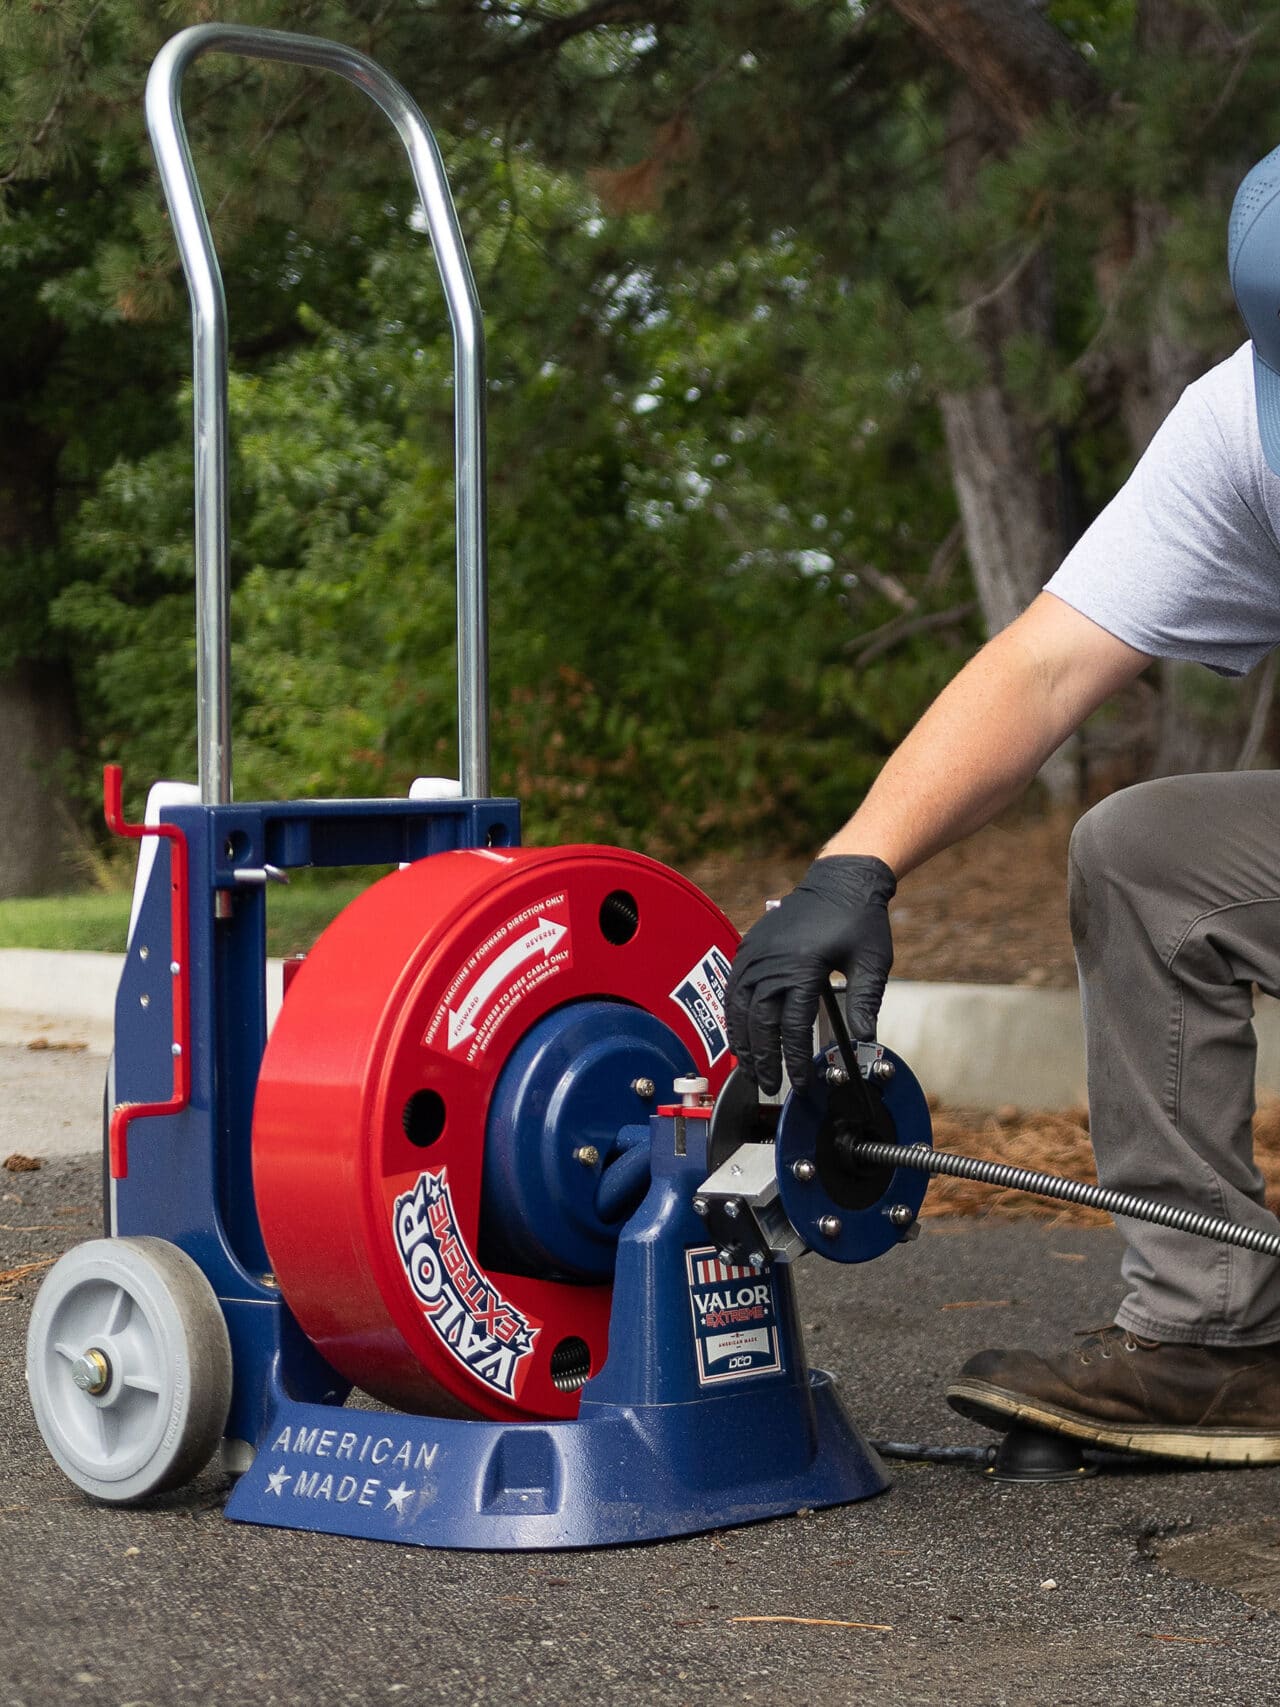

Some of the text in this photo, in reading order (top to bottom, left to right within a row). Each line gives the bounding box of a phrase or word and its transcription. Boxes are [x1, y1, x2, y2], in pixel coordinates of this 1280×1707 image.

[425, 894, 565, 1045] OPERATE MACHINE IN FORWARD DIRECTION ONLY
[454, 928, 557, 1037] FORWARD REVERSE
[467, 950, 569, 1062] USE REVERSE TO FREE CABLE ONLY
[711, 980, 725, 1004] BLE
[398, 1182, 517, 1388] VALOR
[427, 1196, 521, 1343] EXTREME
[693, 1285, 771, 1314] VALOR
[705, 1305, 765, 1328] EXTREME
[271, 1426, 440, 1471] AMERICAN
[293, 1470, 382, 1507] MADE
